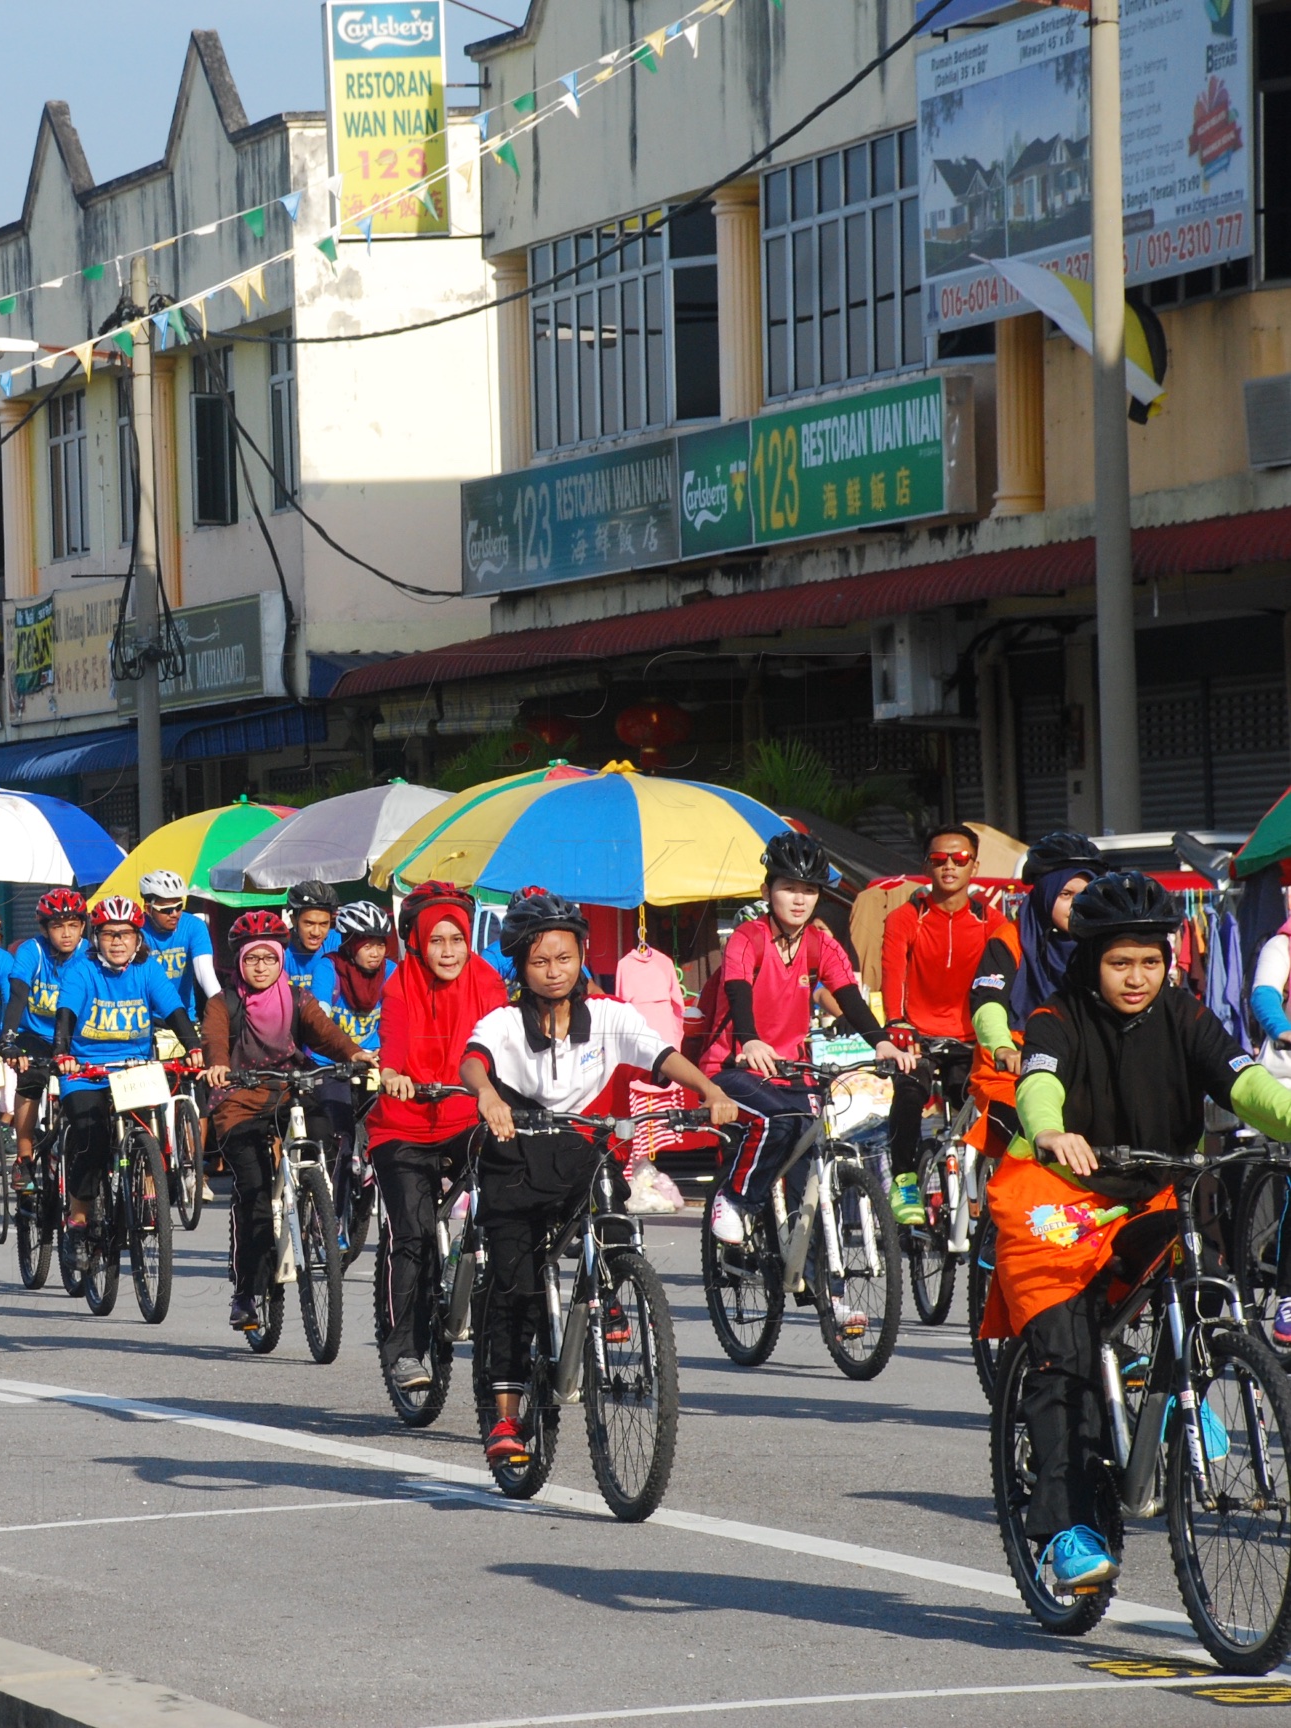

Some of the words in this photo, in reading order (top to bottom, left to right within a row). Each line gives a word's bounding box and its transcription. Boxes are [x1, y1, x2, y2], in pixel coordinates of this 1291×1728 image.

[337, 9, 435, 44] Carlsberg
[1017, 26, 1040, 43] Rumah
[931, 55, 953, 71] Rumah
[953, 43, 989, 65] Berkembar
[346, 70, 432, 99] RESTORAN
[344, 110, 386, 138] WAN
[393, 108, 438, 137] NIAN
[358, 148, 428, 180] 123
[941, 277, 998, 319] 016-6014
[1147, 220, 1211, 268] 019-2310
[1216, 212, 1243, 250] 777
[754, 425, 800, 532] 123
[801, 408, 868, 469] RESTORAN
[870, 402, 903, 454] WAN
[905, 393, 941, 448] NIAN
[682, 469, 728, 522] Carlsberg
[822, 466, 910, 520] 海鮮飯店
[513, 482, 552, 573] 123
[556, 468, 610, 521] RESTORAN
[612, 462, 640, 510] WAN
[642, 455, 672, 502] NIAN
[466, 519, 509, 572] Carlsberg
[85, 1004, 150, 1031] 1MYC
[1031, 1220, 1068, 1235] TOGETH
